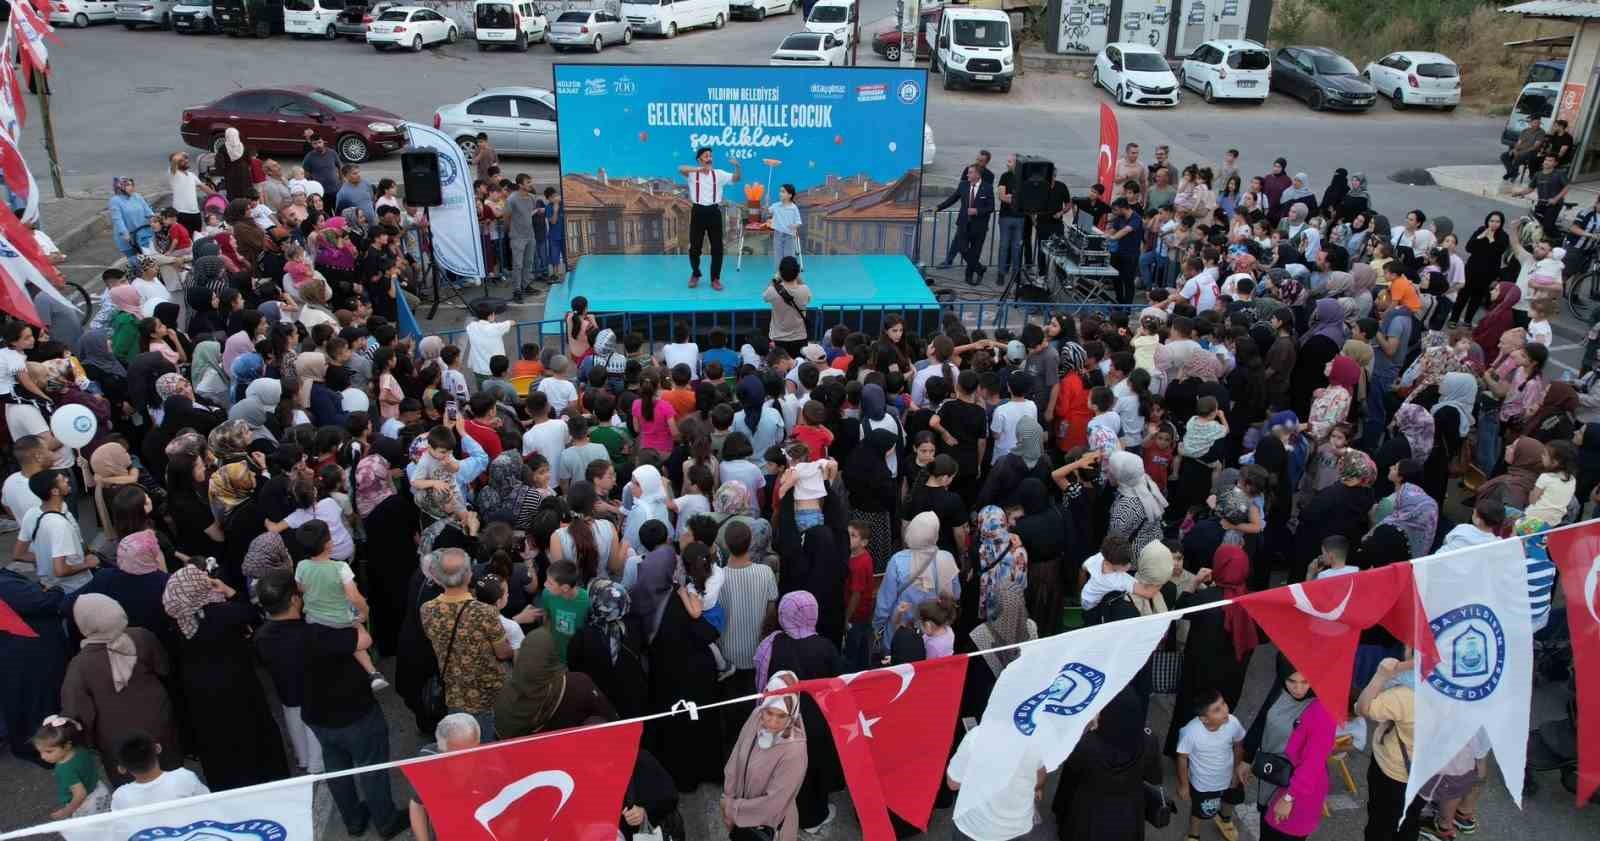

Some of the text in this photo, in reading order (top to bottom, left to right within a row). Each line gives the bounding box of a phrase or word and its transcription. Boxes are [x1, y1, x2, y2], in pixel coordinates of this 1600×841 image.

[707, 86, 779, 101] YILDIRIM BELEDİYESİ
[647, 102, 725, 126] GELENEKSEL
[729, 103, 788, 127] MAHALLE
